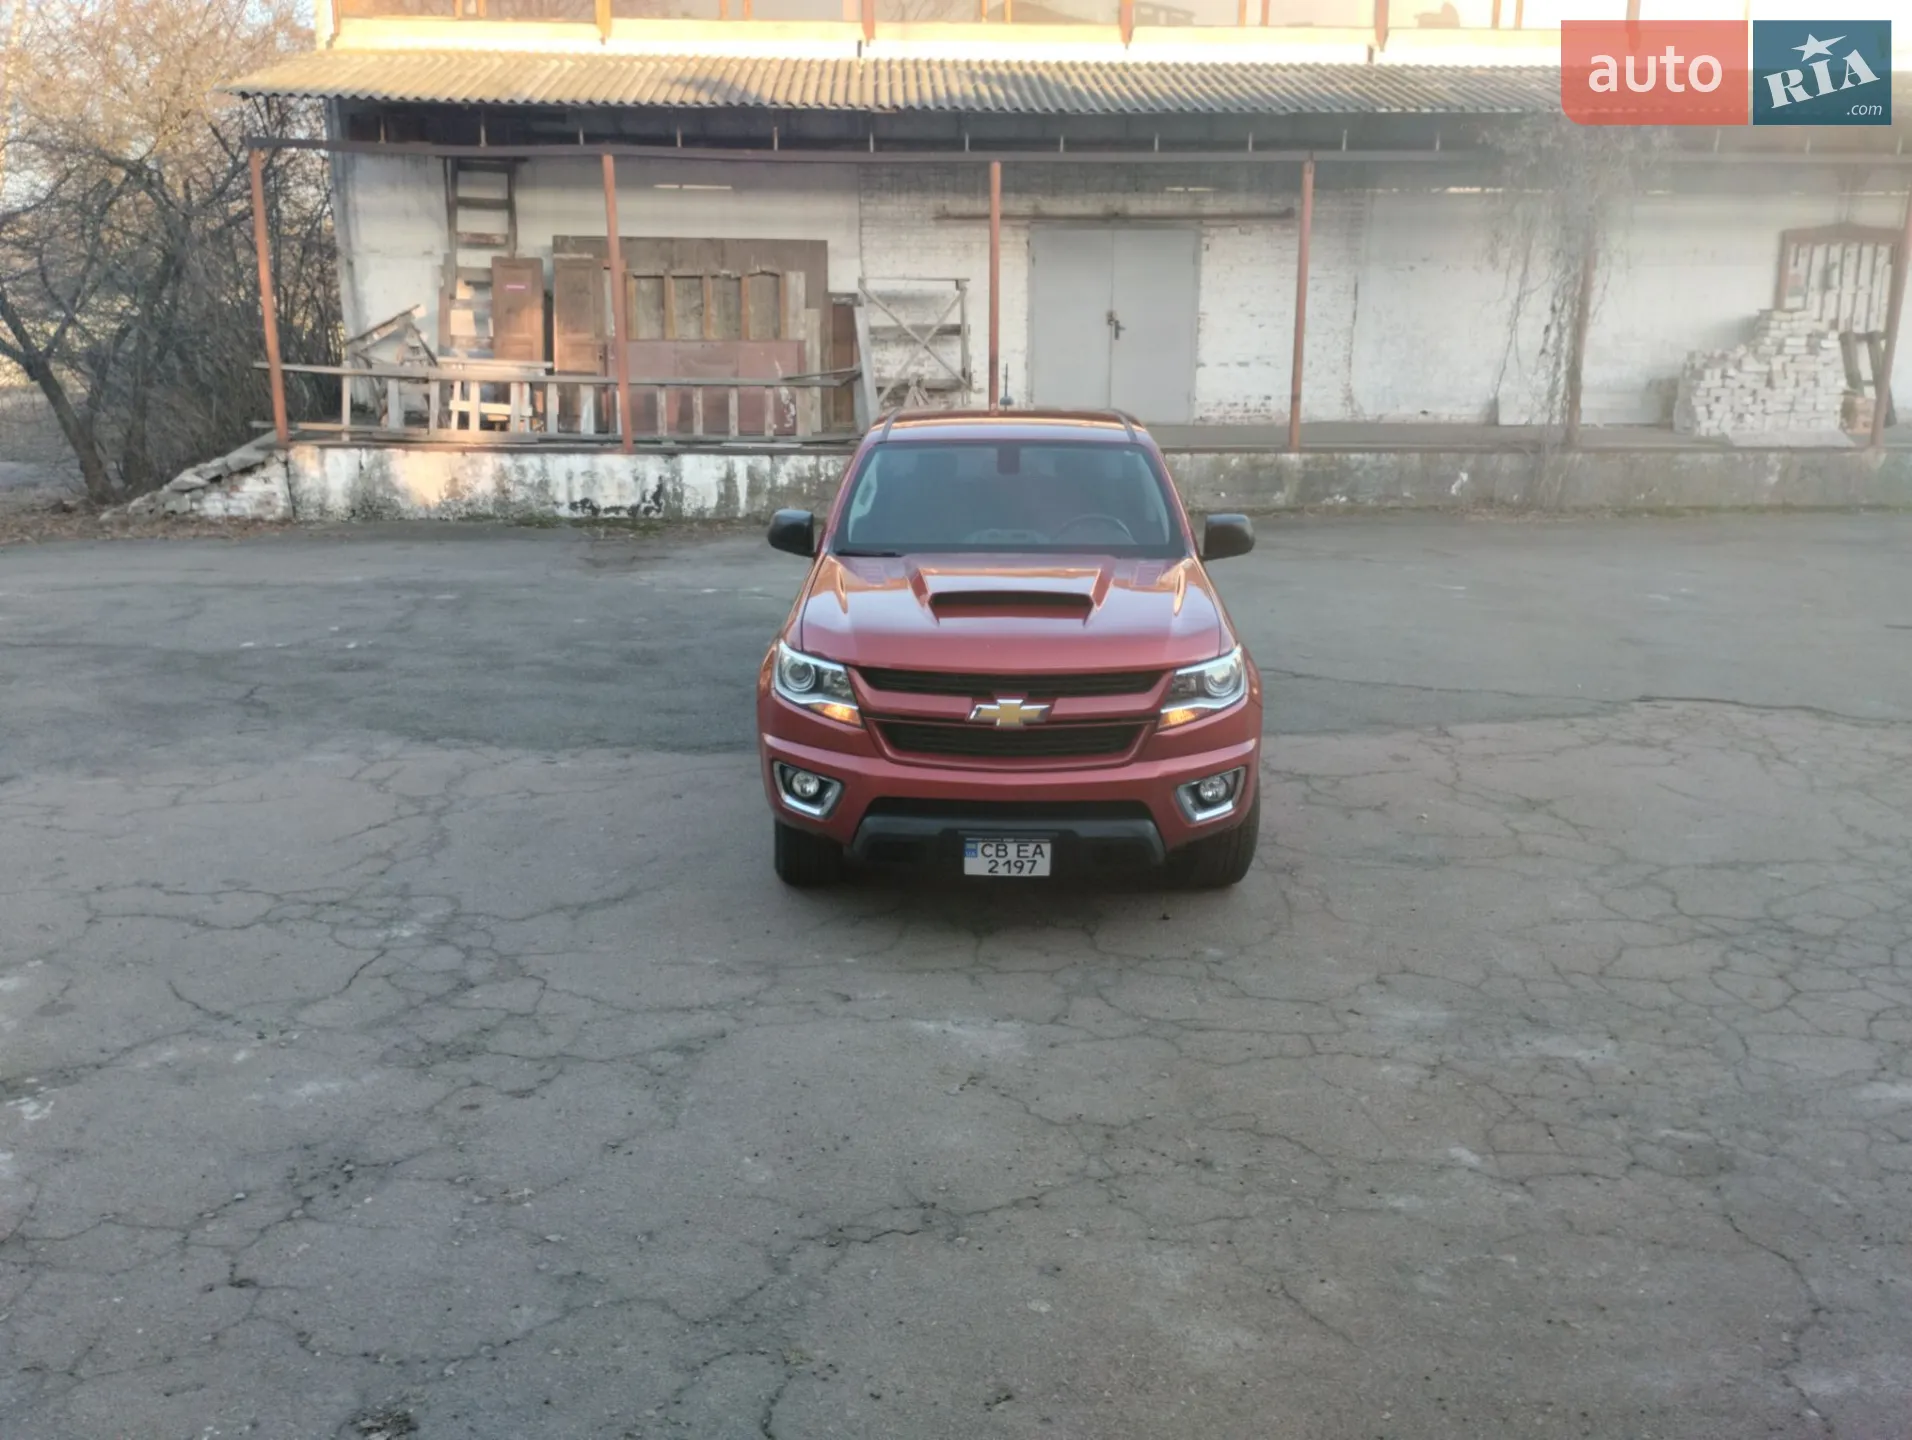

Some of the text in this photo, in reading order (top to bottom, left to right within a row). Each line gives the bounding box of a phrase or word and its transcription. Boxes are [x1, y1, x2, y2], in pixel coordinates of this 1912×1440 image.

[980, 843, 1045, 858] CB EA
[988, 859, 1038, 874] 2197
